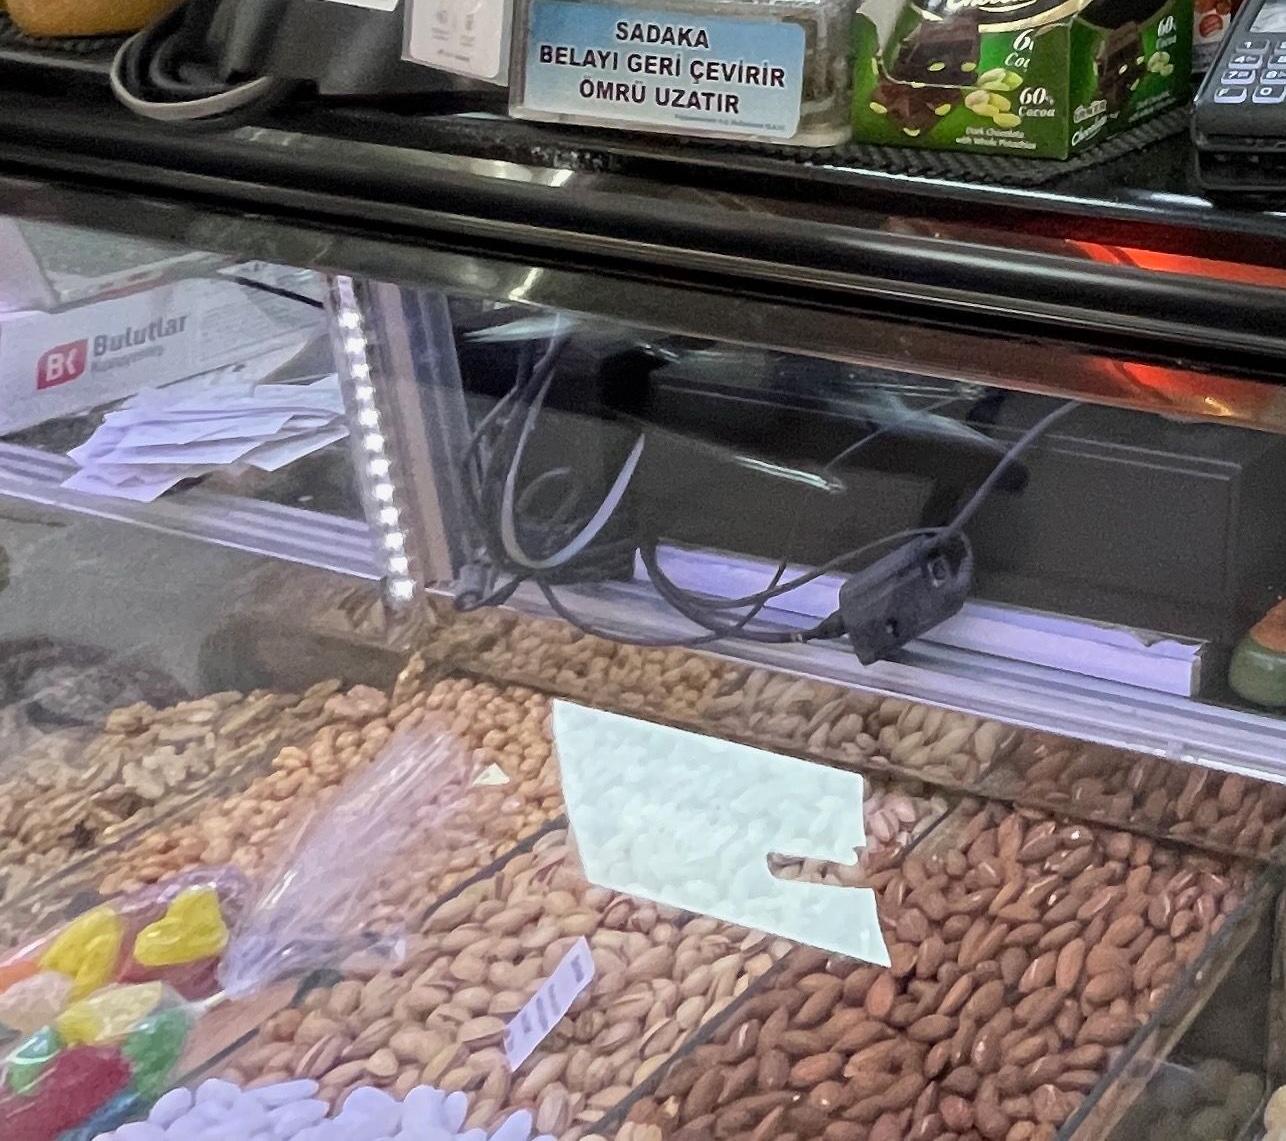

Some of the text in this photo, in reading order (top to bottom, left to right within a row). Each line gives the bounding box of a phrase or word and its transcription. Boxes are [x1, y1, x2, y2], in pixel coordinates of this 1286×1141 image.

[614, 21, 710, 49] SADAKA
[539, 45, 786, 88] BELAYI GERİ ÇEVİRİR
[578, 75, 740, 114] ÖMRÜ UZATIR
[92, 314, 189, 357] Bulutlar
